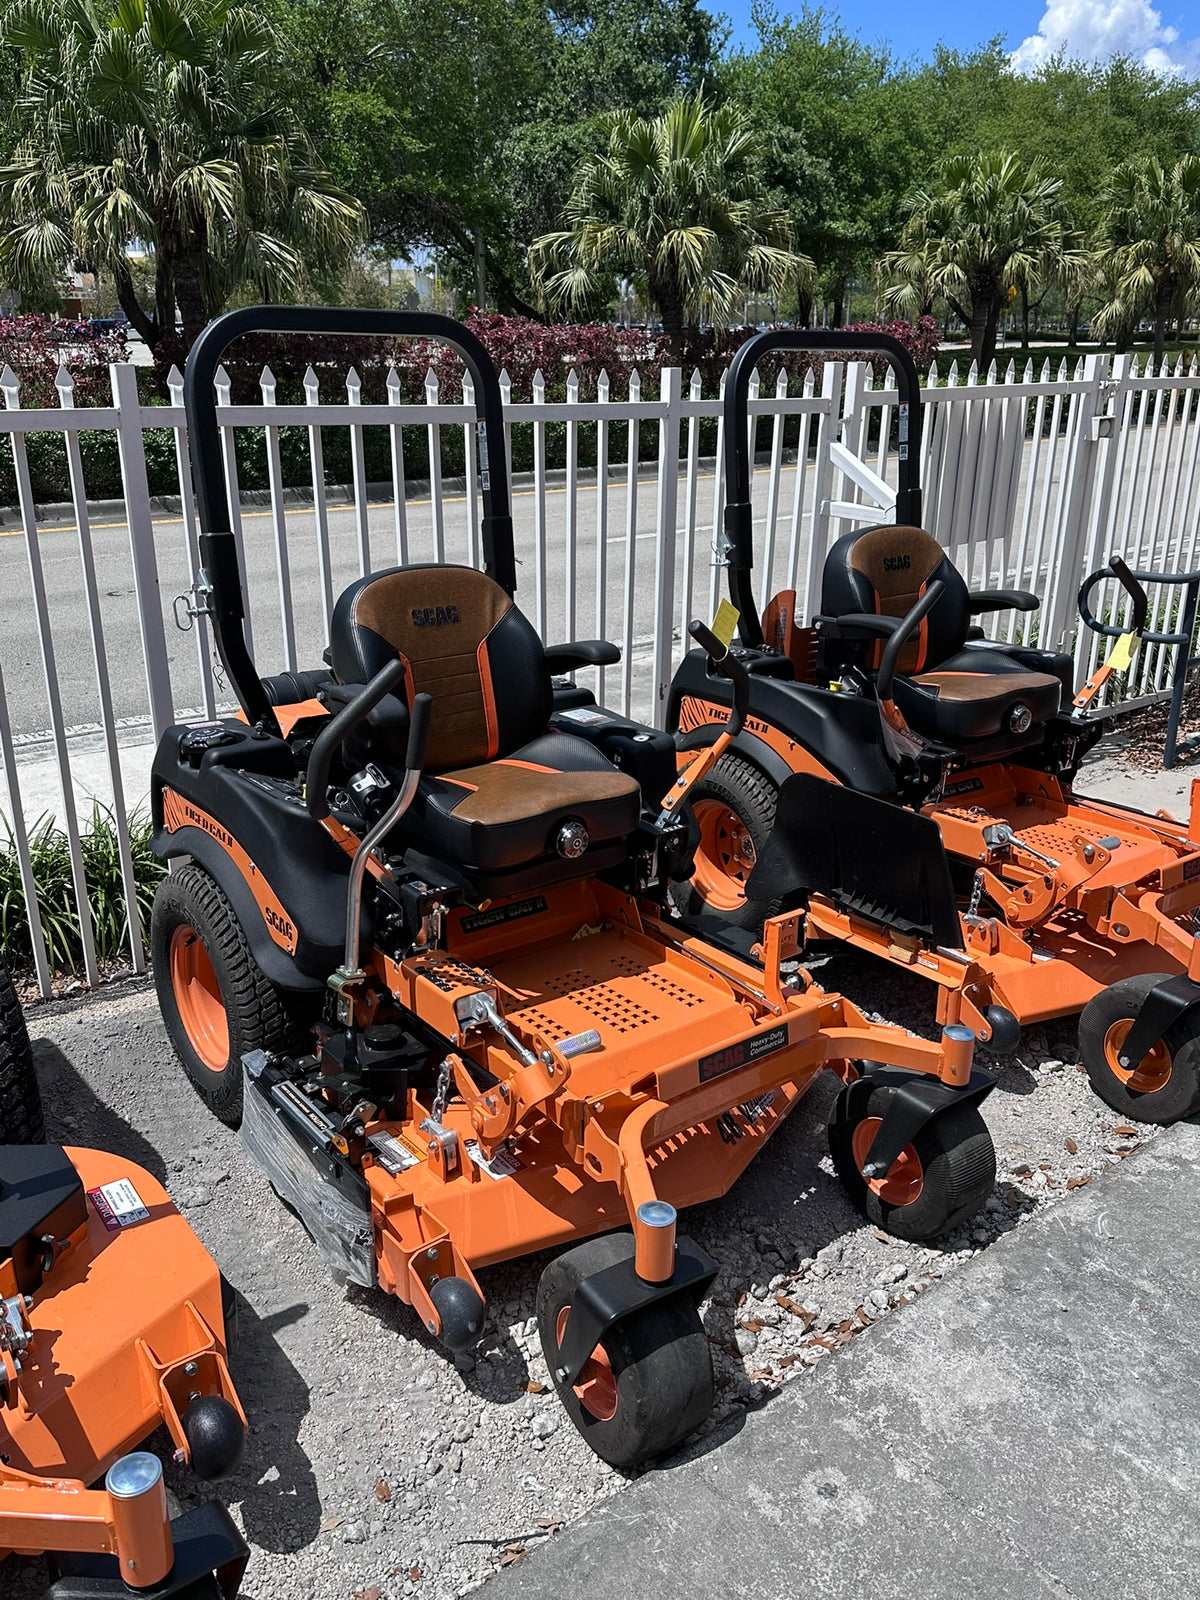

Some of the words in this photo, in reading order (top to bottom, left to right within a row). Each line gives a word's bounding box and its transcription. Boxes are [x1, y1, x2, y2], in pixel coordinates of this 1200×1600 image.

[882, 554, 911, 571] SCAG
[411, 605, 460, 627] SCAG
[709, 708, 732, 722] TIGE
[744, 720, 761, 731] AT
[265, 906, 293, 941] SCAG
[463, 909, 506, 930] TIGER
[508, 901, 536, 917] CAT
[749, 1036, 785, 1057] Commercial
[750, 1030, 785, 1049] Heavy-Duty
[702, 1045, 745, 1078] SCAG
[92, 1192, 113, 1218] DANGER
